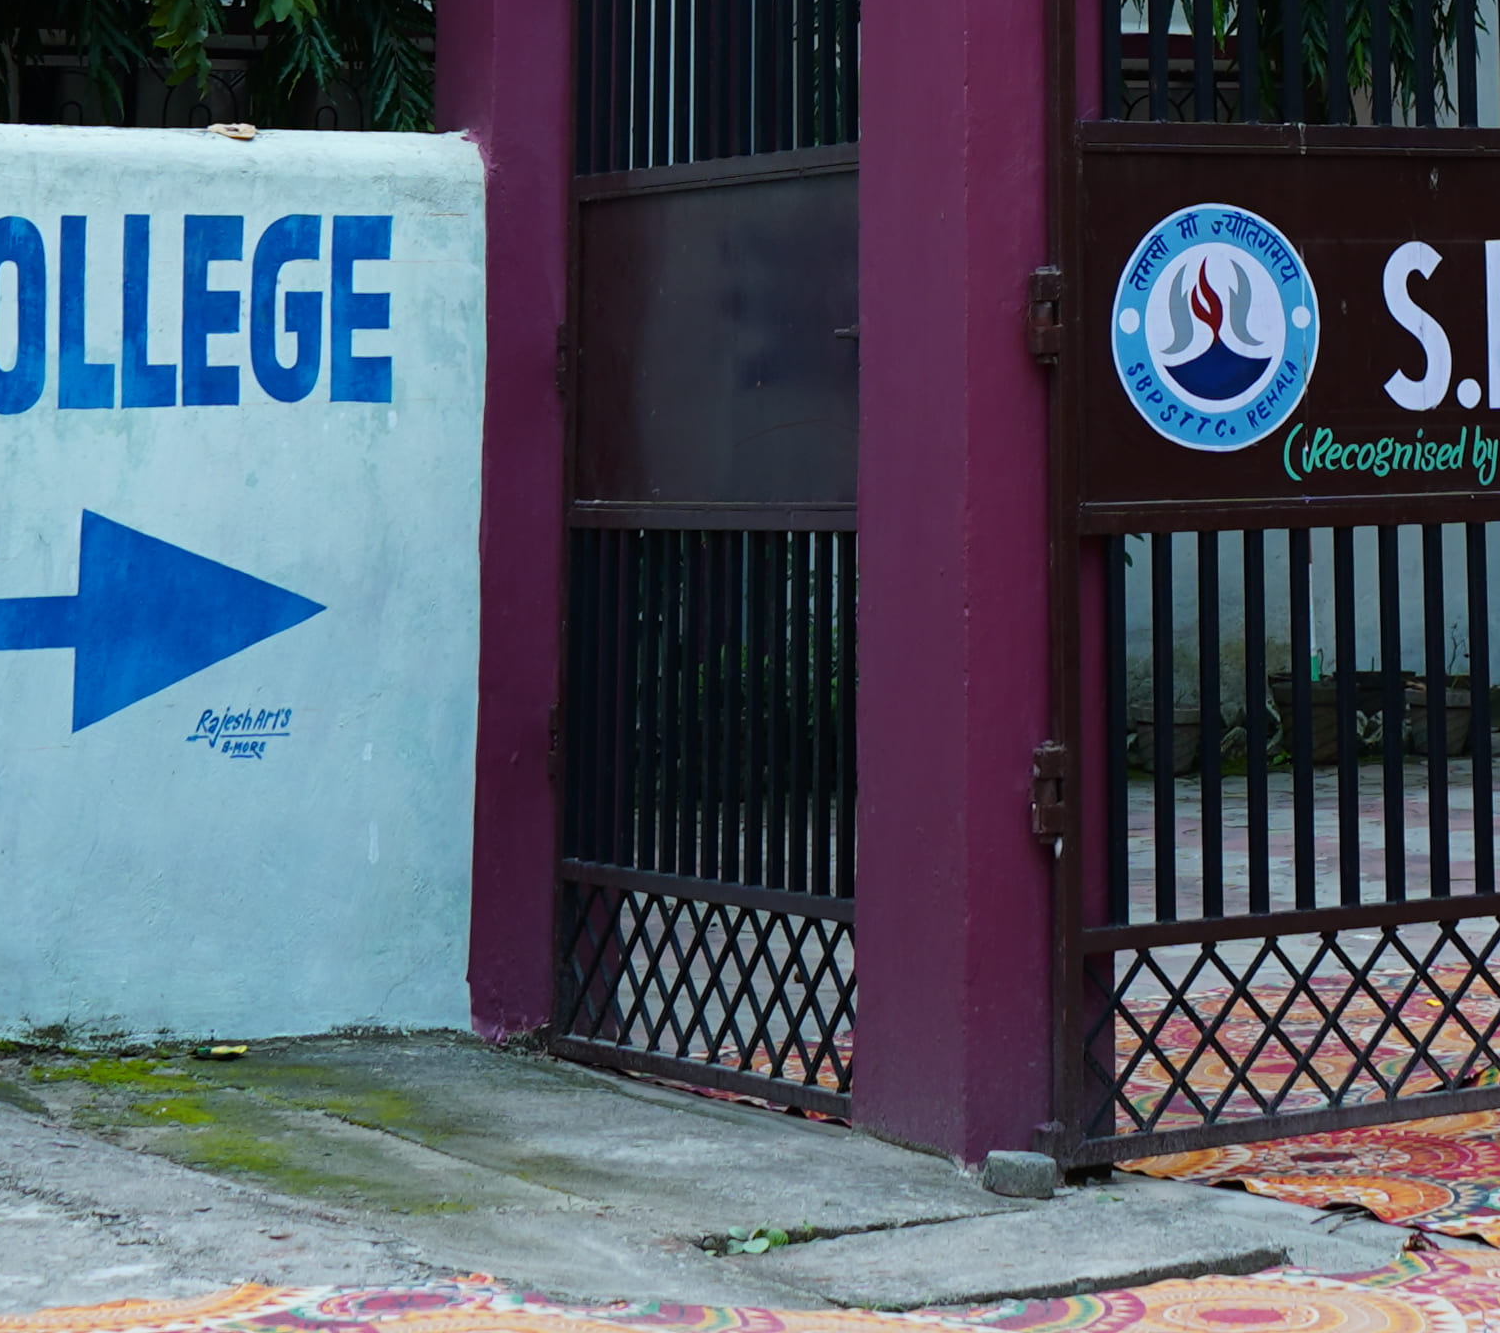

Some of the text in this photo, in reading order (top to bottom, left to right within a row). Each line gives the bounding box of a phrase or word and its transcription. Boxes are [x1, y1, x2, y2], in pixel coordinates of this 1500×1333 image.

[1245, 359, 1299, 429] REHALA
[1471, 425, 1499, 485] by
[196, 706, 253, 748] Rajesh
